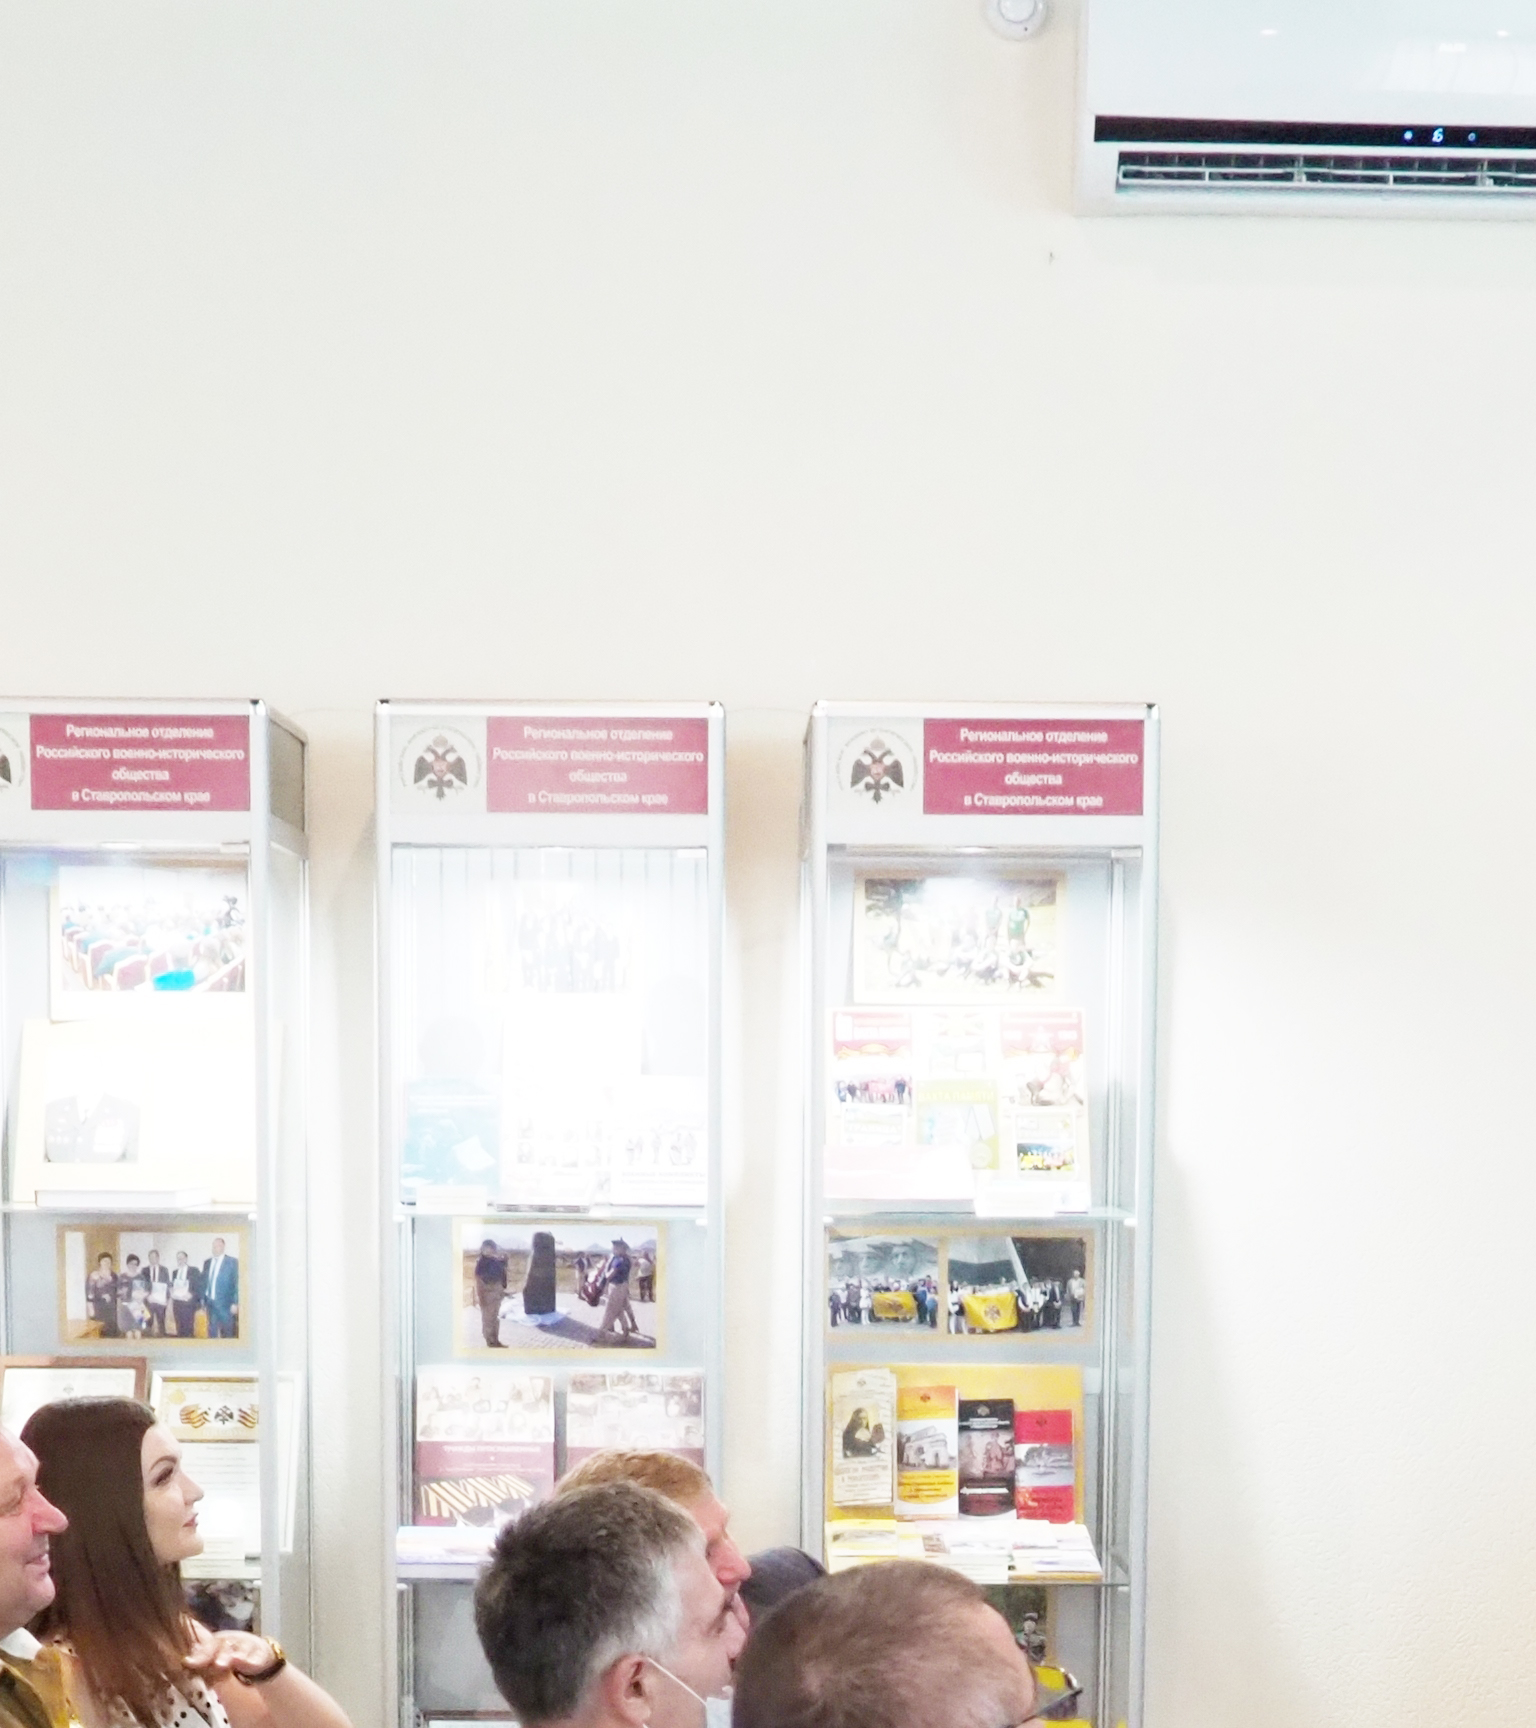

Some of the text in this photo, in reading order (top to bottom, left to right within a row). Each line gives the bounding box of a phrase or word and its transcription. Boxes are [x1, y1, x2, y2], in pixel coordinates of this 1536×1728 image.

[66, 724, 214, 740] Региональное отделение
[959, 728, 1108, 743] Региональное отделение
[36, 745, 111, 760] Российского
[929, 749, 1004, 764] Российского
[112, 768, 169, 782] общества
[1005, 772, 1062, 786] общества
